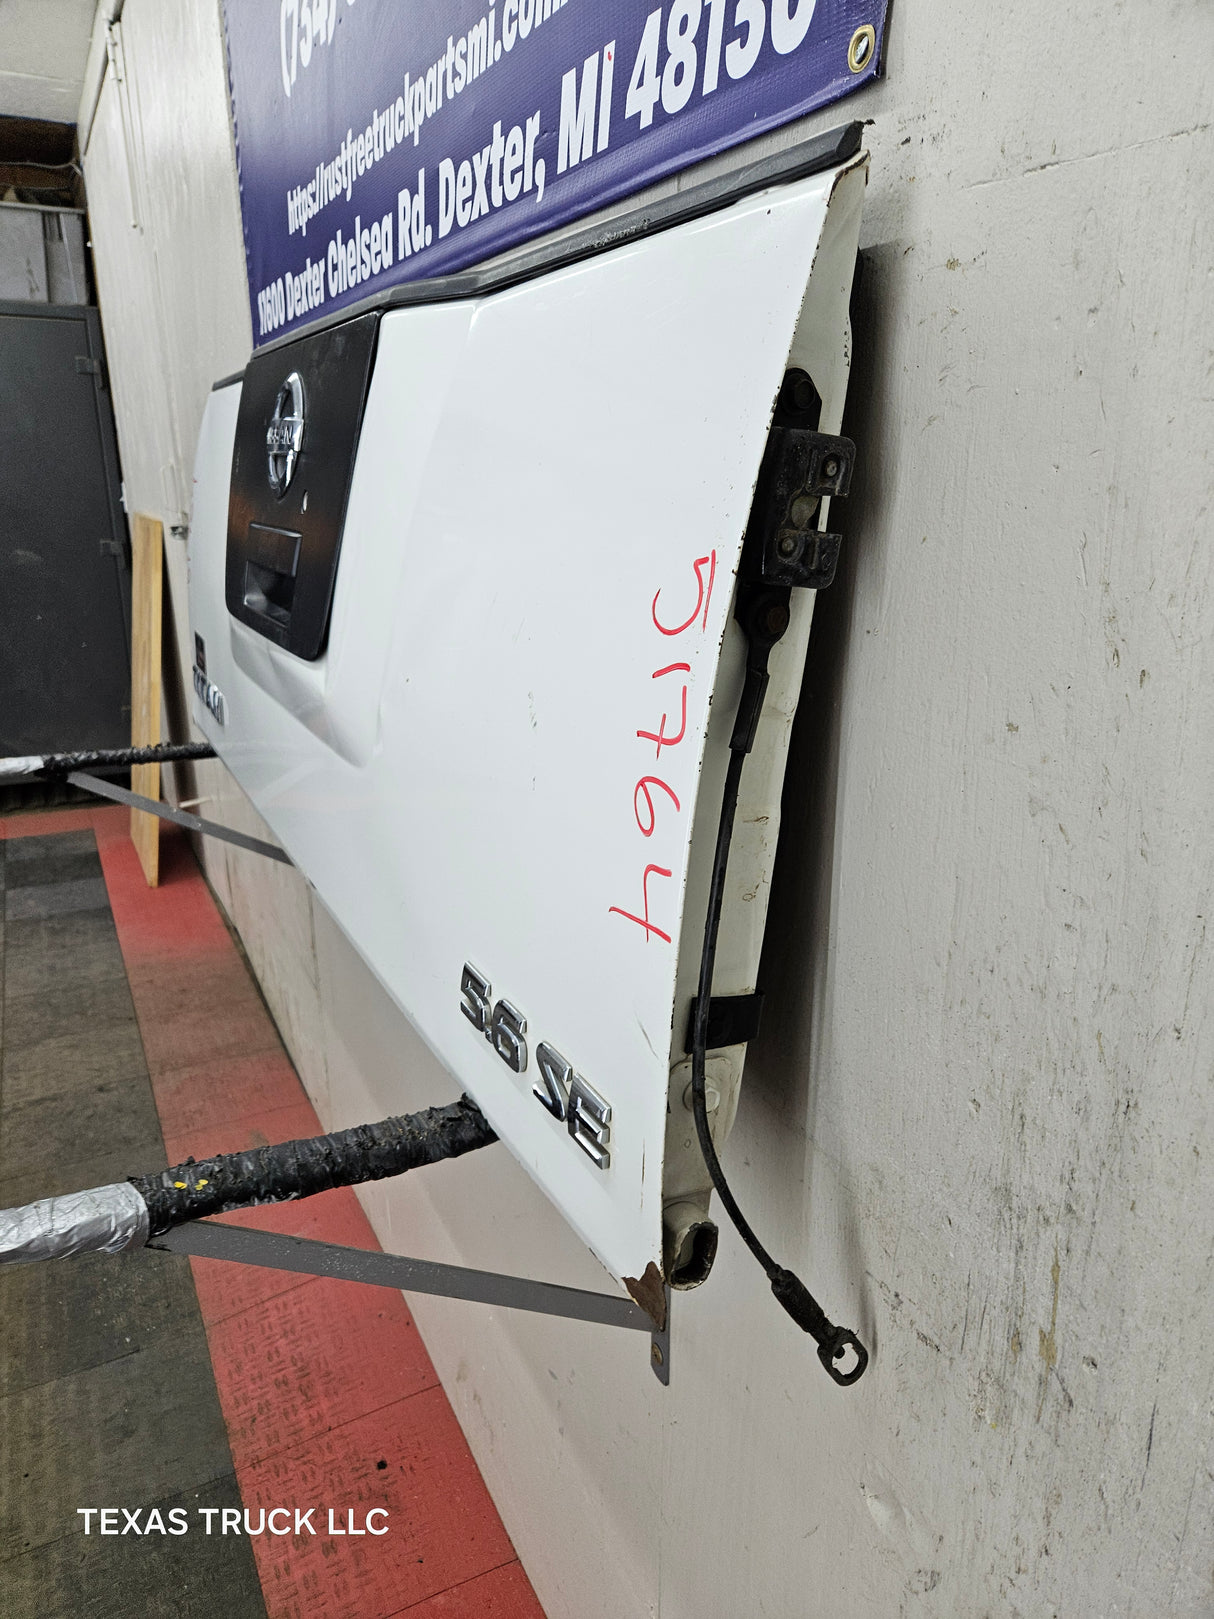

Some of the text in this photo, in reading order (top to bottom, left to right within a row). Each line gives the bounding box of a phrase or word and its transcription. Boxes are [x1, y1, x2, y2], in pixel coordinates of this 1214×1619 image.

[257, 277, 286, 335] 11600
[284, 257, 325, 321] Dexter
[327, 211, 393, 298] Chelsea
[398, 167, 433, 261] Rd.
[438, 109, 545, 239] Dexter,
[556, 39, 616, 175] MI
[287, 0, 568, 236] https://rustfreetruckpartsmi.co
[608, 549, 716, 943] 51764
[460, 960, 612, 1170] 5.6 SE
